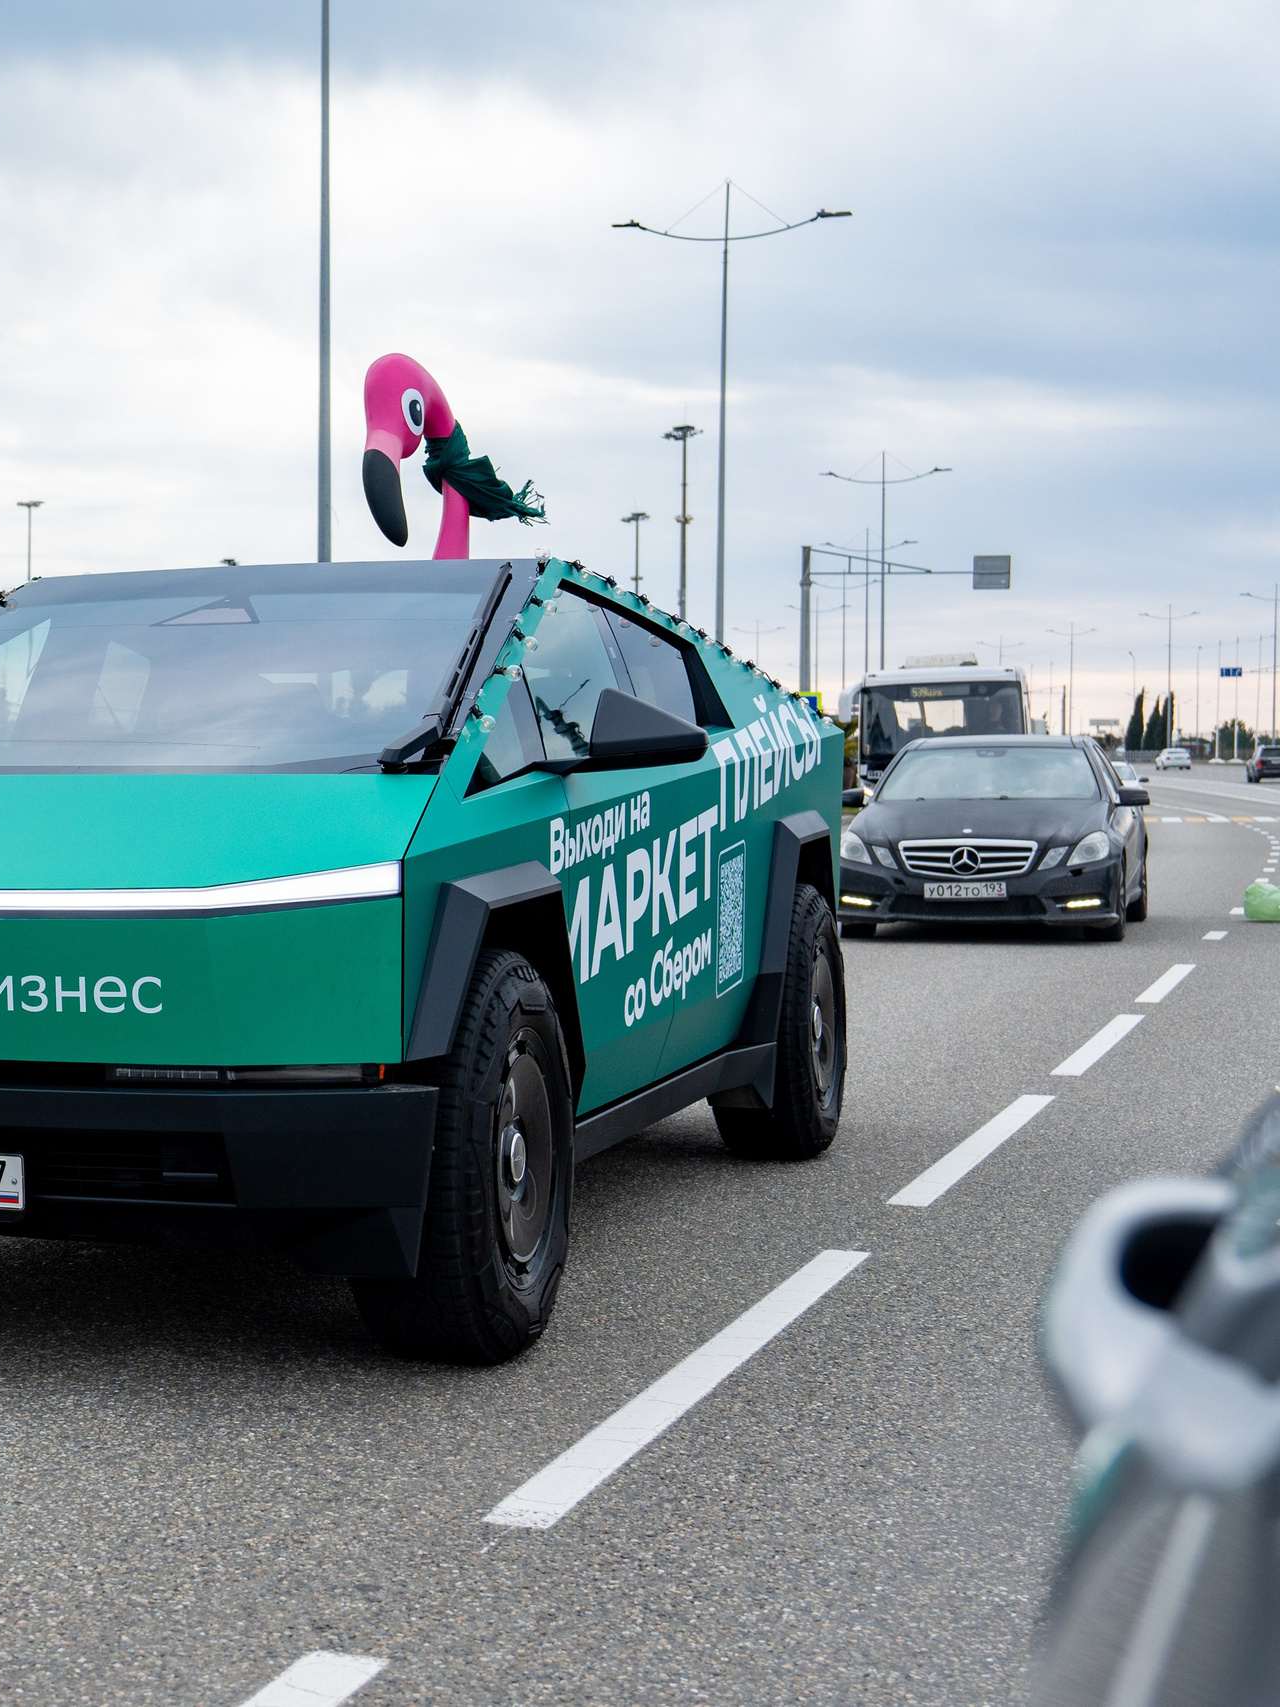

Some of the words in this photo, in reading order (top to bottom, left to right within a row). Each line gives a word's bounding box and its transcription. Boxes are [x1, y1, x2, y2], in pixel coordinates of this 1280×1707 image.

[711, 693, 821, 832] ПЛЕЙСЫ
[550, 802, 625, 875] Выходи
[630, 791, 651, 835] на
[928, 884, 980, 897] У012ТО
[982, 882, 1003, 893] 193
[624, 977, 646, 1028] со
[650, 928, 712, 1006] Сбером
